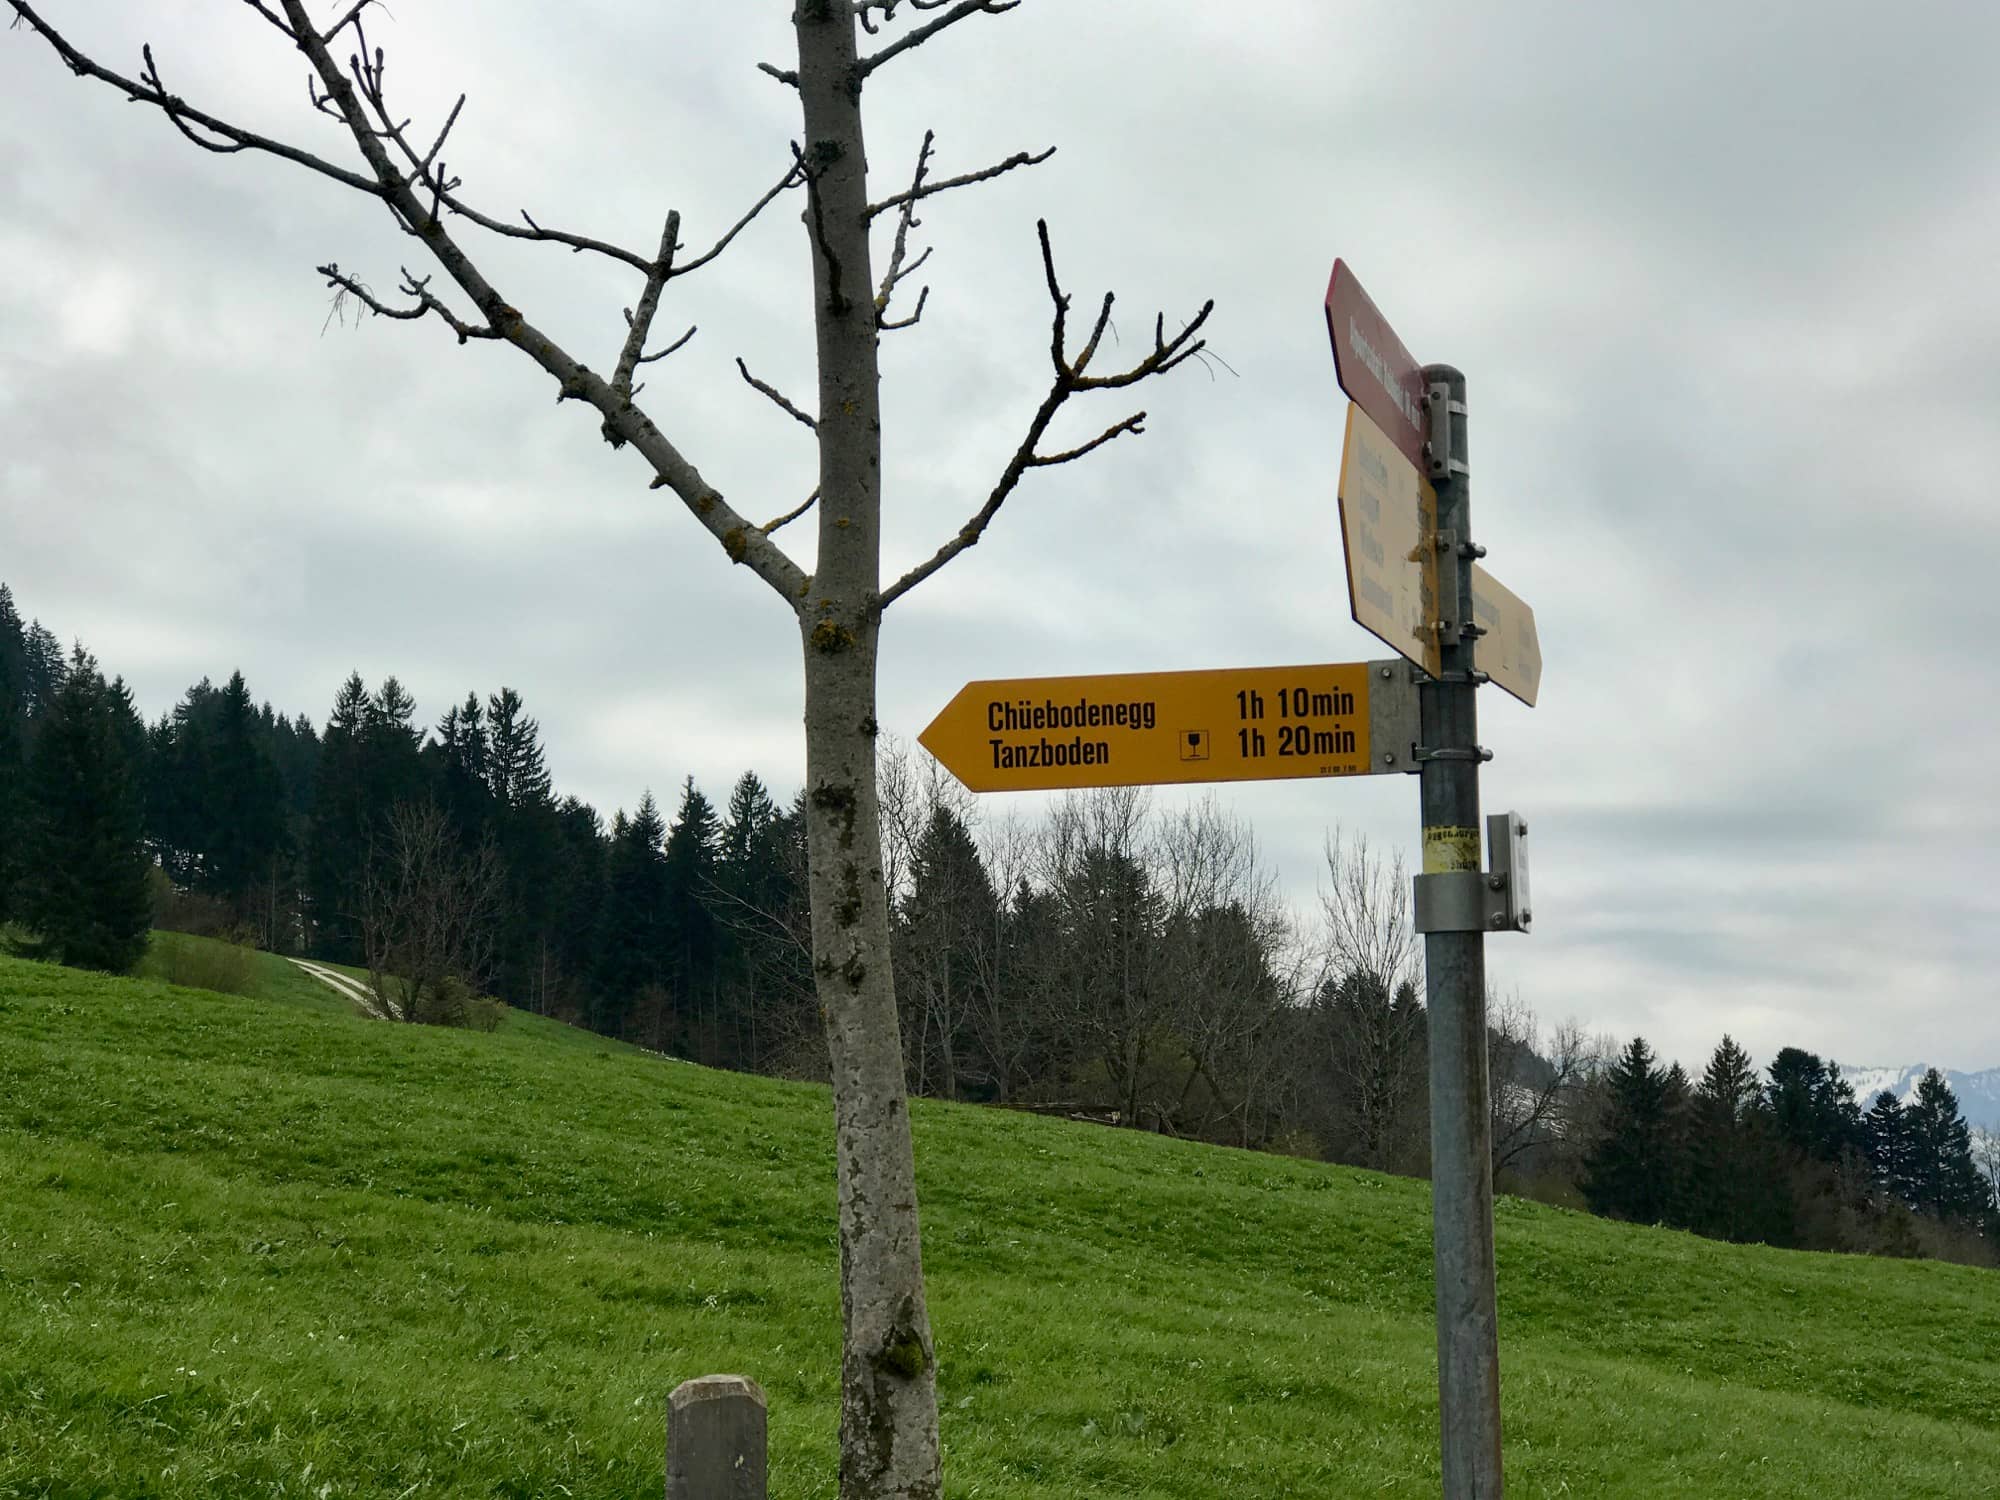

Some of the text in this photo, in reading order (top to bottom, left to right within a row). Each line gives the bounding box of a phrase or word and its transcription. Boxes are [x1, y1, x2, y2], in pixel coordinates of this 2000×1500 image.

[988, 698, 1156, 732] Chüebodenegg
[1236, 689, 1265, 721] 1h
[988, 735, 1110, 769] Tanzboden
[1238, 727, 1266, 759] 1h
